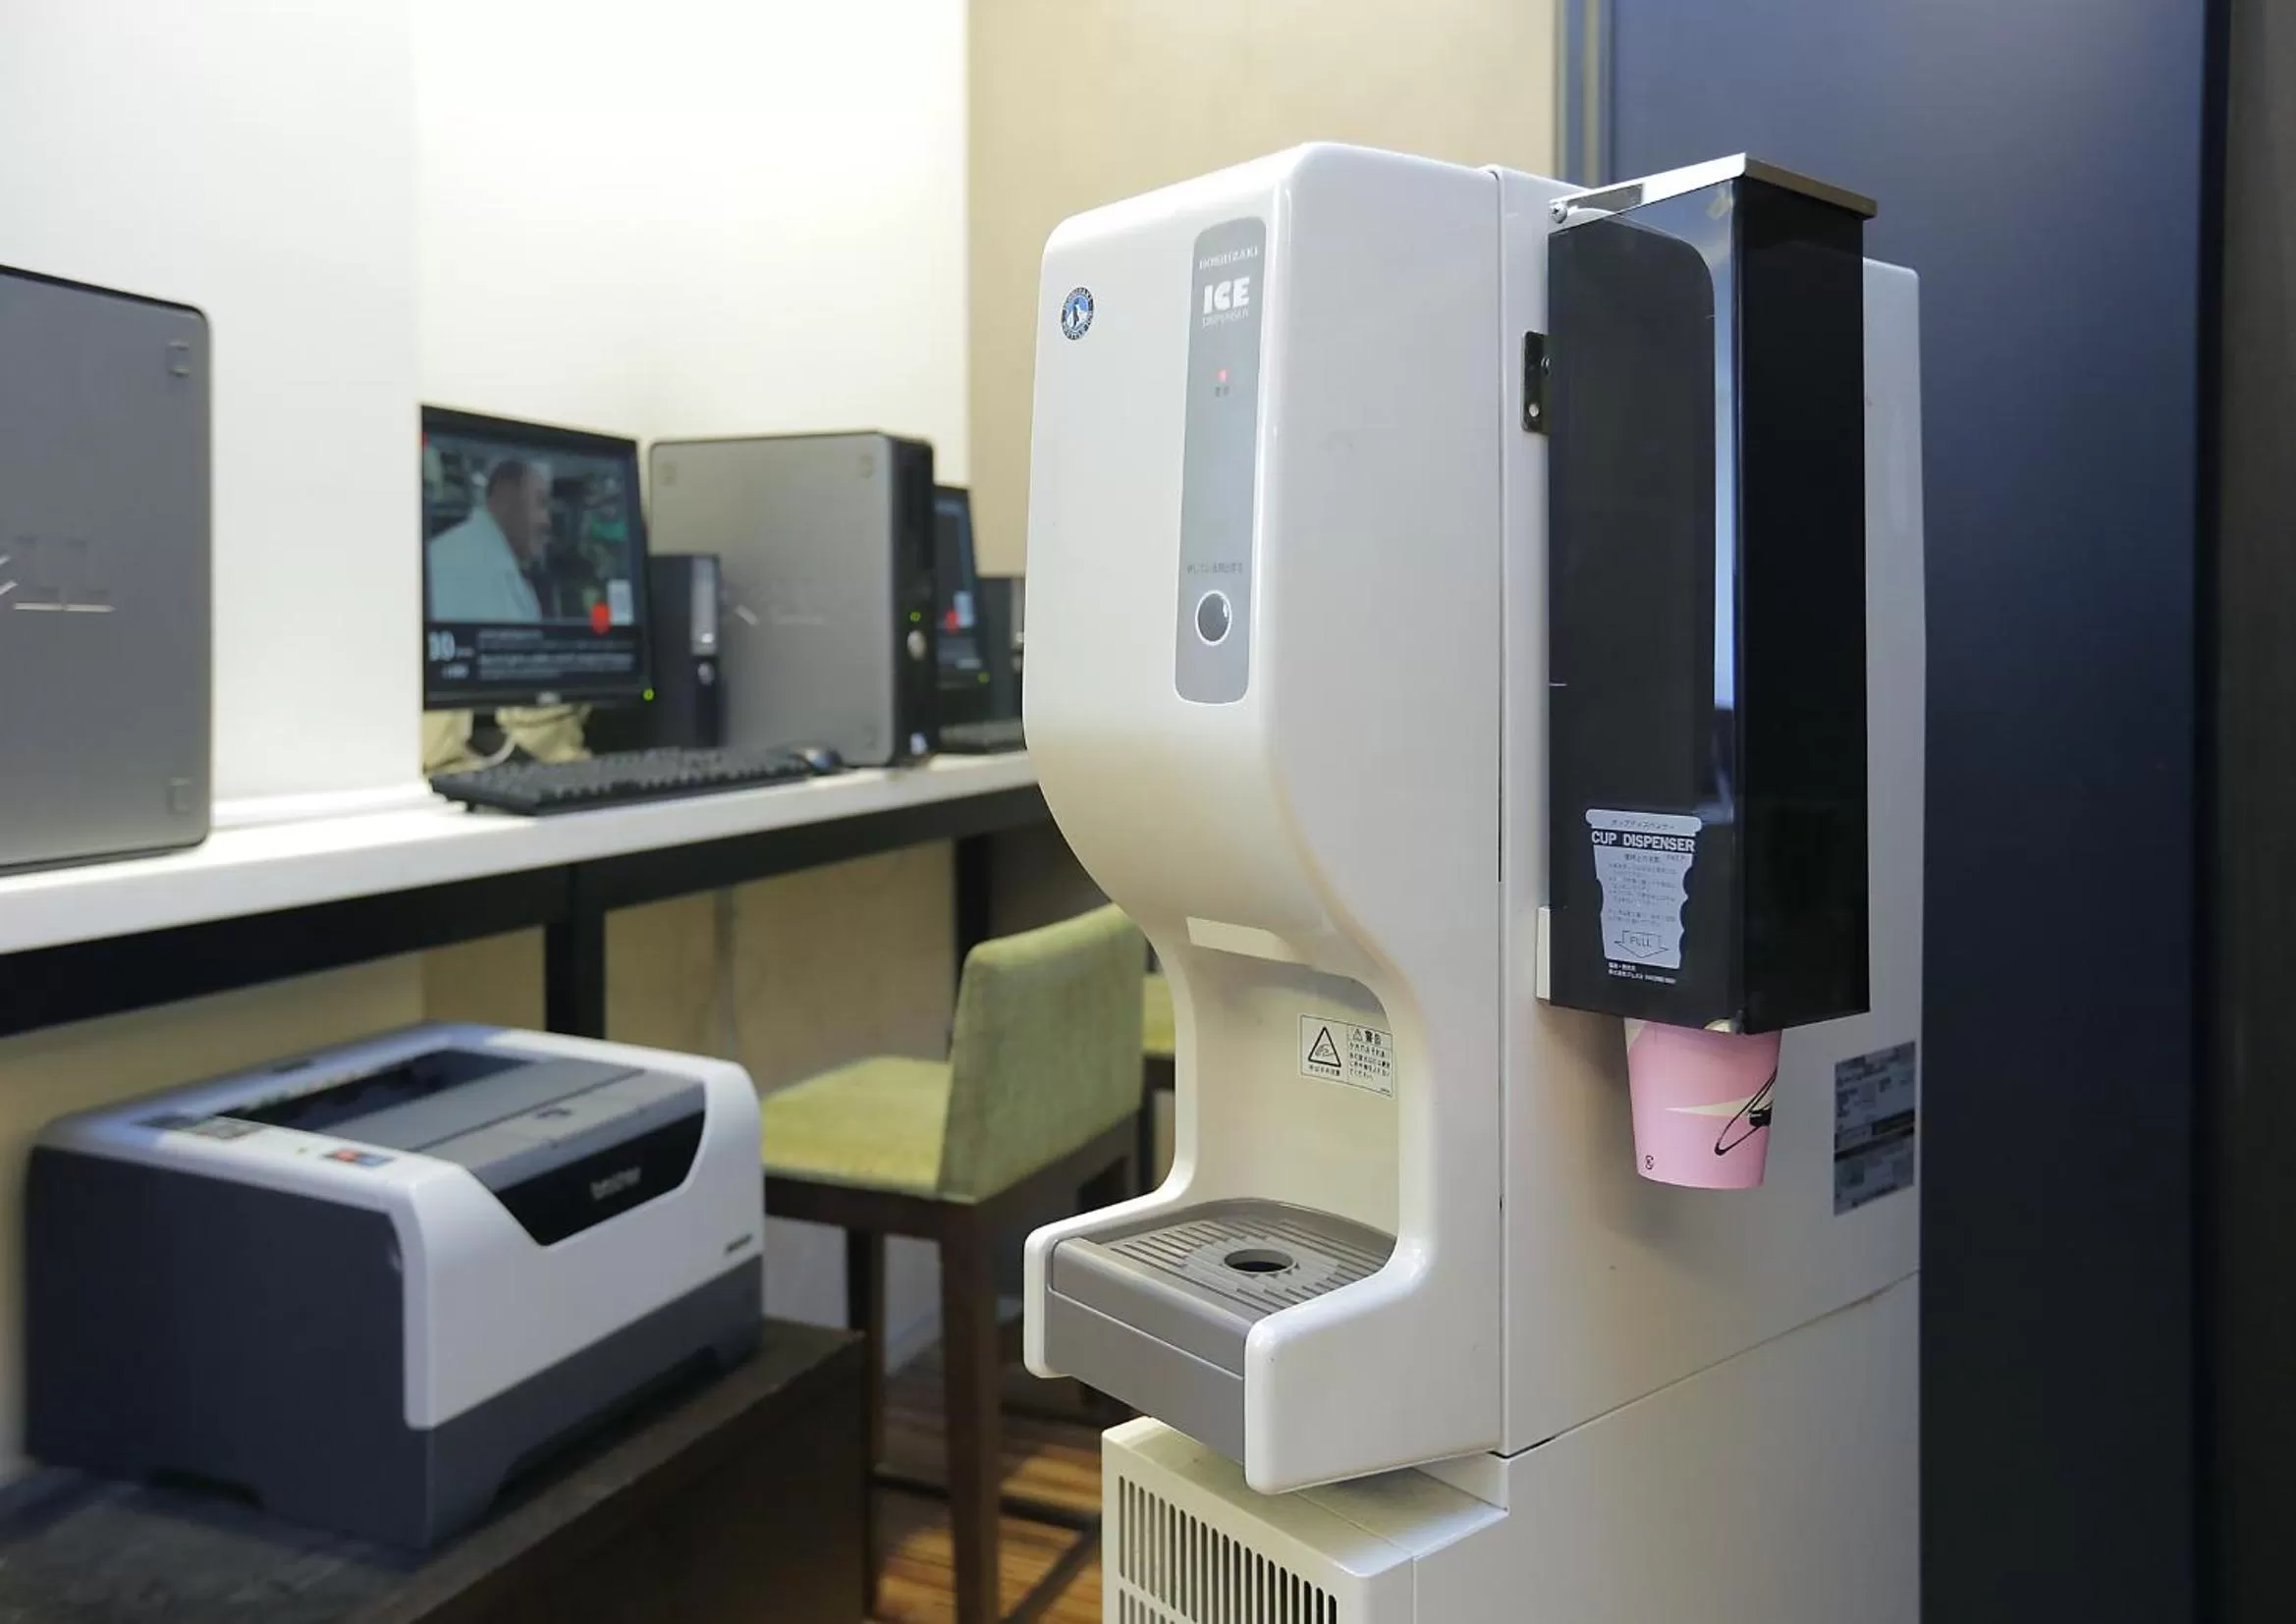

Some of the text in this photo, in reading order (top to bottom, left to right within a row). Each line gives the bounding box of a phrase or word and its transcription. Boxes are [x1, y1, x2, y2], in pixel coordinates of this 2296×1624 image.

[1203, 276, 1250, 314] ICE
[1591, 830, 1696, 852] CUP DISPENSER
